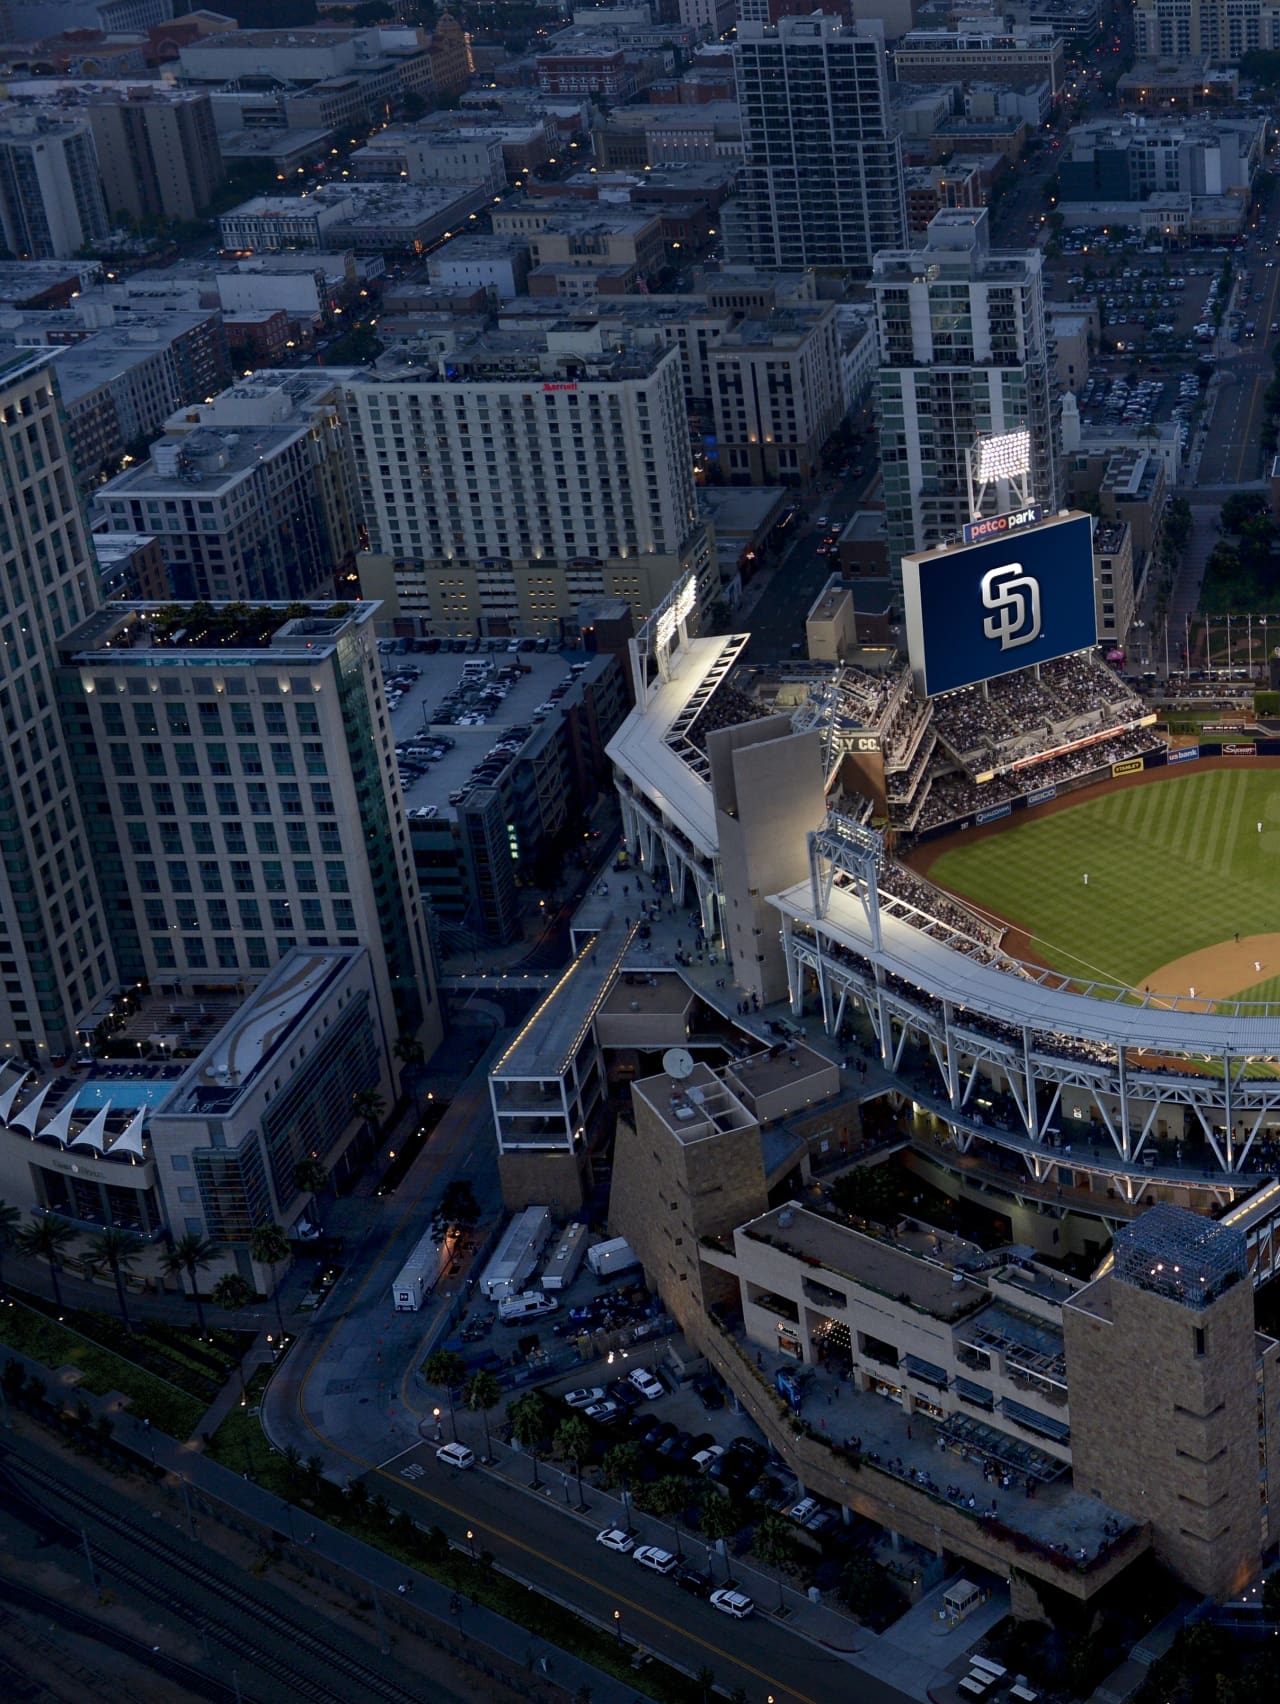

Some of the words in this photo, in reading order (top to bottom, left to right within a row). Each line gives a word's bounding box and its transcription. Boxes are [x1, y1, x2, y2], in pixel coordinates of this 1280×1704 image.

[970, 518, 1007, 539] petco
[1008, 509, 1036, 529] park
[981, 562, 1041, 652] SD
[858, 738, 881, 750] CO.
[1028, 788, 1055, 803] GEICO
[976, 805, 1010, 822] QUALCOMM
